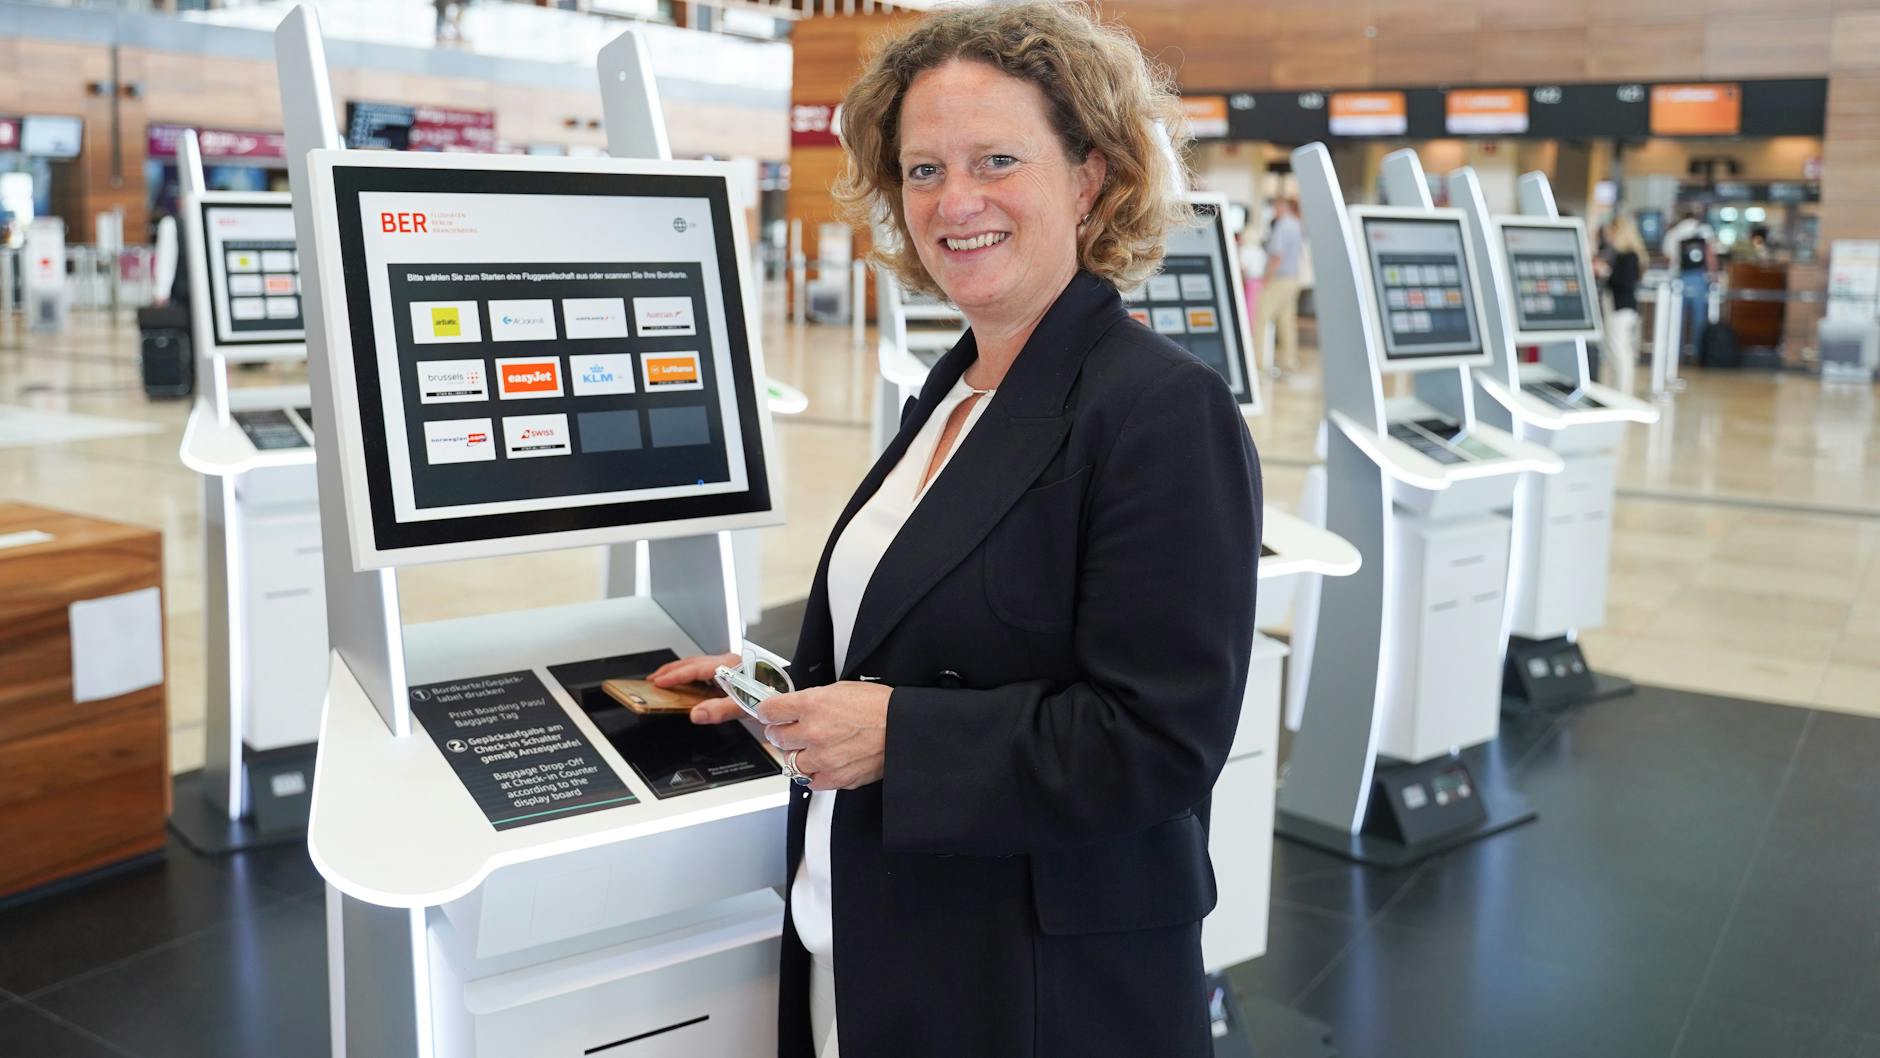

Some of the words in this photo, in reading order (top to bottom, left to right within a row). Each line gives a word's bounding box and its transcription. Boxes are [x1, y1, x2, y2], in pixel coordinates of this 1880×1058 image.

[380, 212, 428, 233] BER
[406, 273, 424, 281] Bitte
[424, 273, 451, 281] wählen
[451, 273, 463, 281] Sie
[480, 272, 506, 280] Starten
[522, 272, 575, 282] Fluggesellschaft
[427, 372, 464, 382] brussels
[507, 371, 552, 385] easyJet
[582, 373, 614, 383] KLM
[531, 429, 554, 437] SWISS
[464, 687, 506, 699] drucken
[448, 709, 474, 719] Print
[474, 701, 520, 714] Boarding
[454, 714, 499, 727] Baggage
[499, 712, 519, 720] Tag
[467, 727, 546, 745] Gepäckaufgabe
[546, 724, 564, 732] am
[474, 740, 520, 754] Check-in
[520, 733, 562, 746] Schalter
[480, 750, 519, 764] gemäß
[519, 739, 582, 756] Anzeigetafel
[492, 766, 539, 781] Baggage
[539, 757, 585, 772] Drop-Off
[512, 773, 558, 787] Check-in
[559, 766, 598, 778] Counter
[507, 784, 558, 798] according
[570, 777, 589, 786] the
[513, 794, 551, 808] display
[551, 788, 583, 800] board
